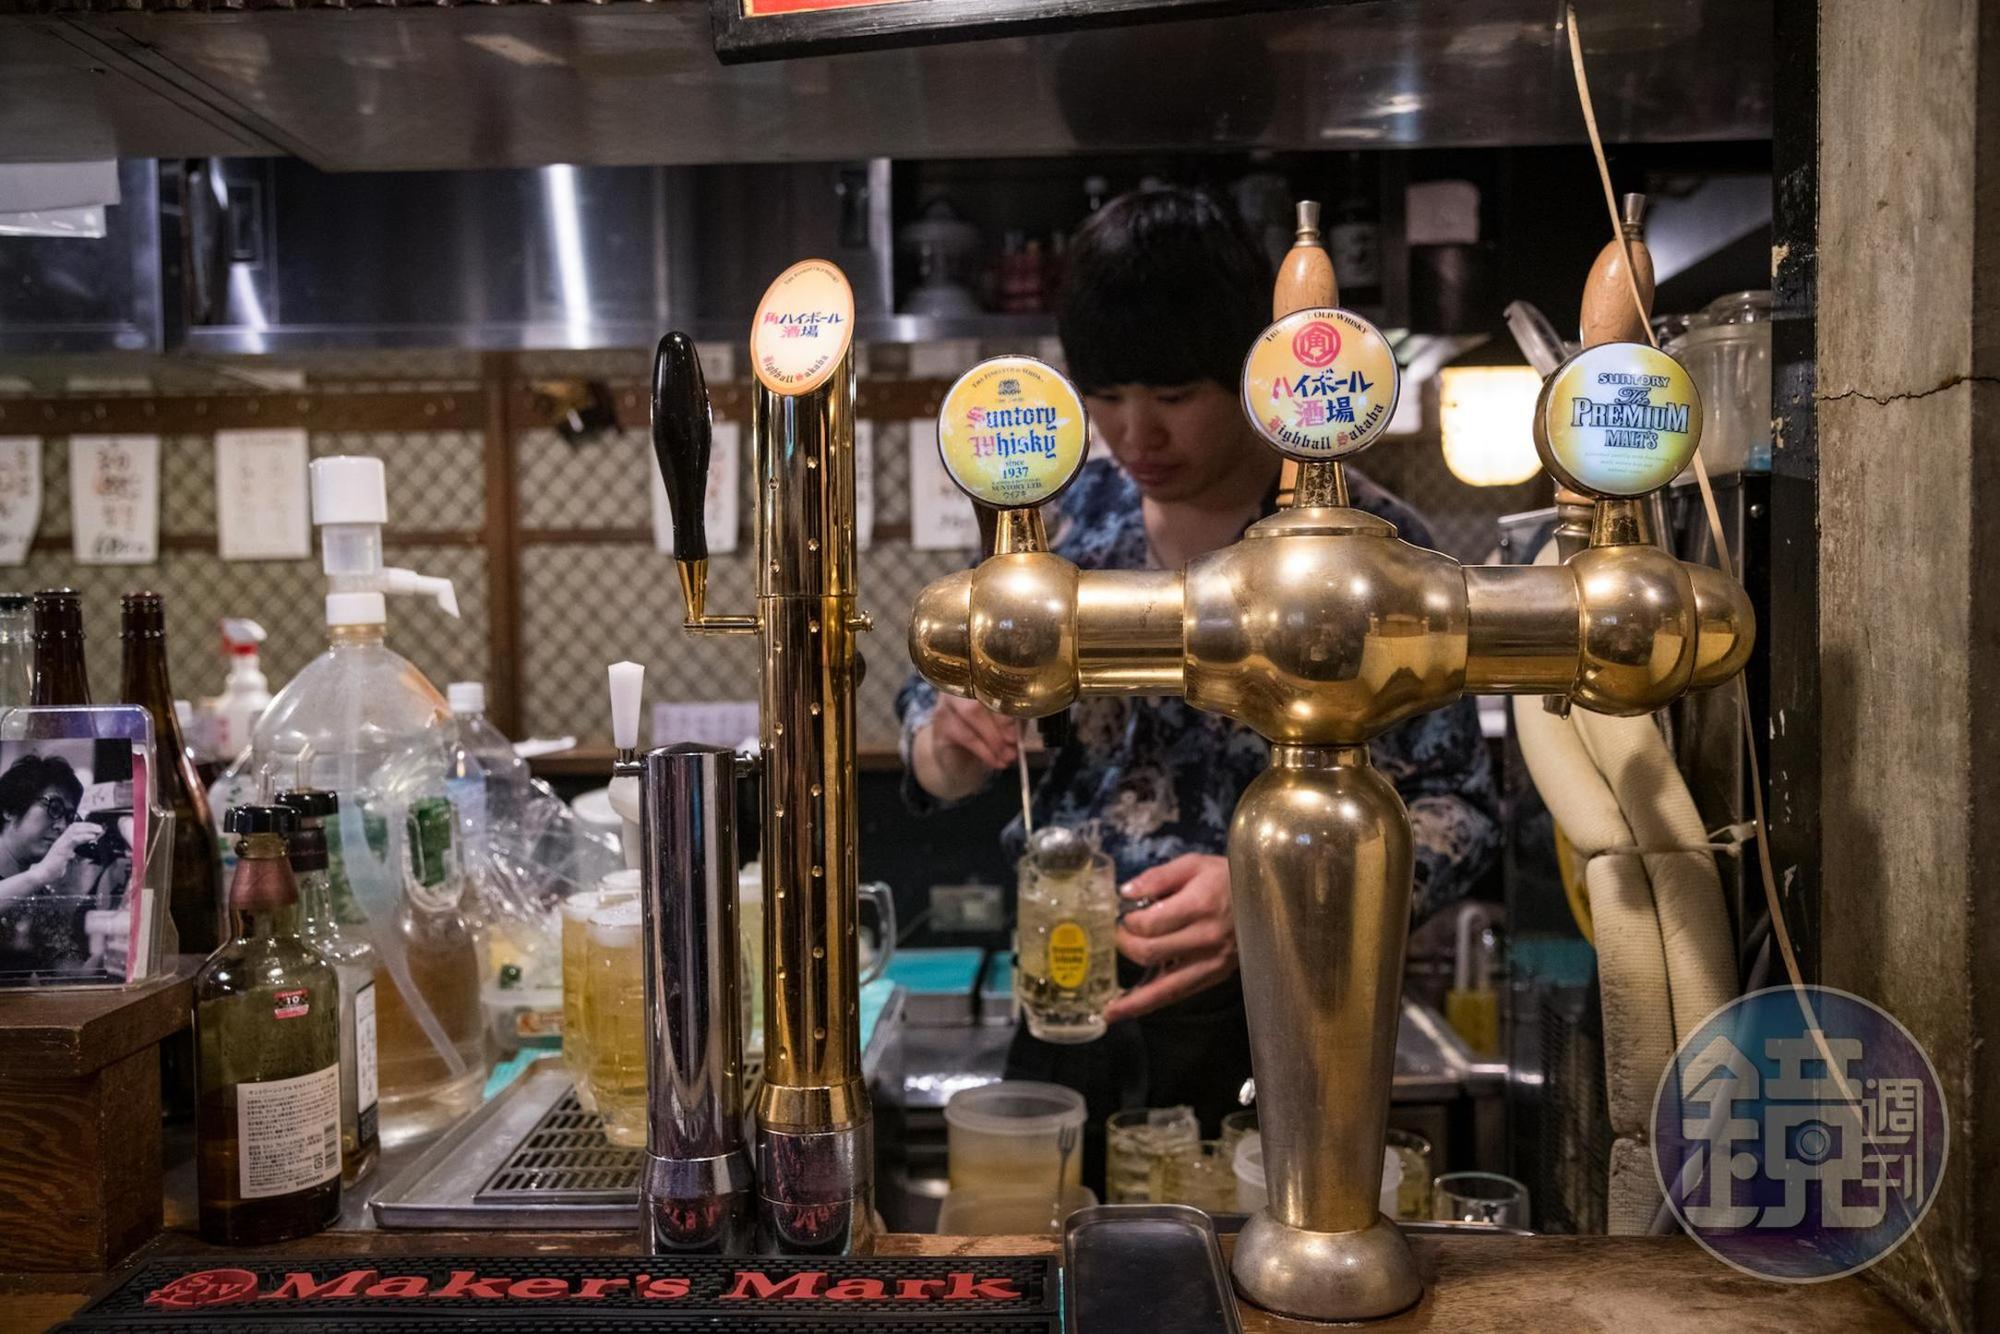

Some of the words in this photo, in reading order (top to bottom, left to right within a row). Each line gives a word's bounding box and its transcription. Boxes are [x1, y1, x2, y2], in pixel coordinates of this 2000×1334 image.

[780, 325, 819, 338] 酒場
[1336, 312, 1368, 334] WHISKY
[1271, 368, 1374, 400] ハイボール
[1598, 372, 1670, 387] SUNTORY
[1614, 387, 1651, 405] The
[966, 406, 1057, 431] Suntory
[1293, 396, 1355, 427] 酒場
[1571, 397, 1690, 433] PREMIUM
[1267, 415, 1332, 450] Highball
[1336, 402, 1384, 446] Sakaba
[968, 430, 1057, 459] Whisky
[1604, 429, 1659, 450] MALT'S
[1003, 466, 1029, 479] 1937
[257, 1269, 691, 1300] Maker's
[719, 1271, 1023, 1301] Mark
